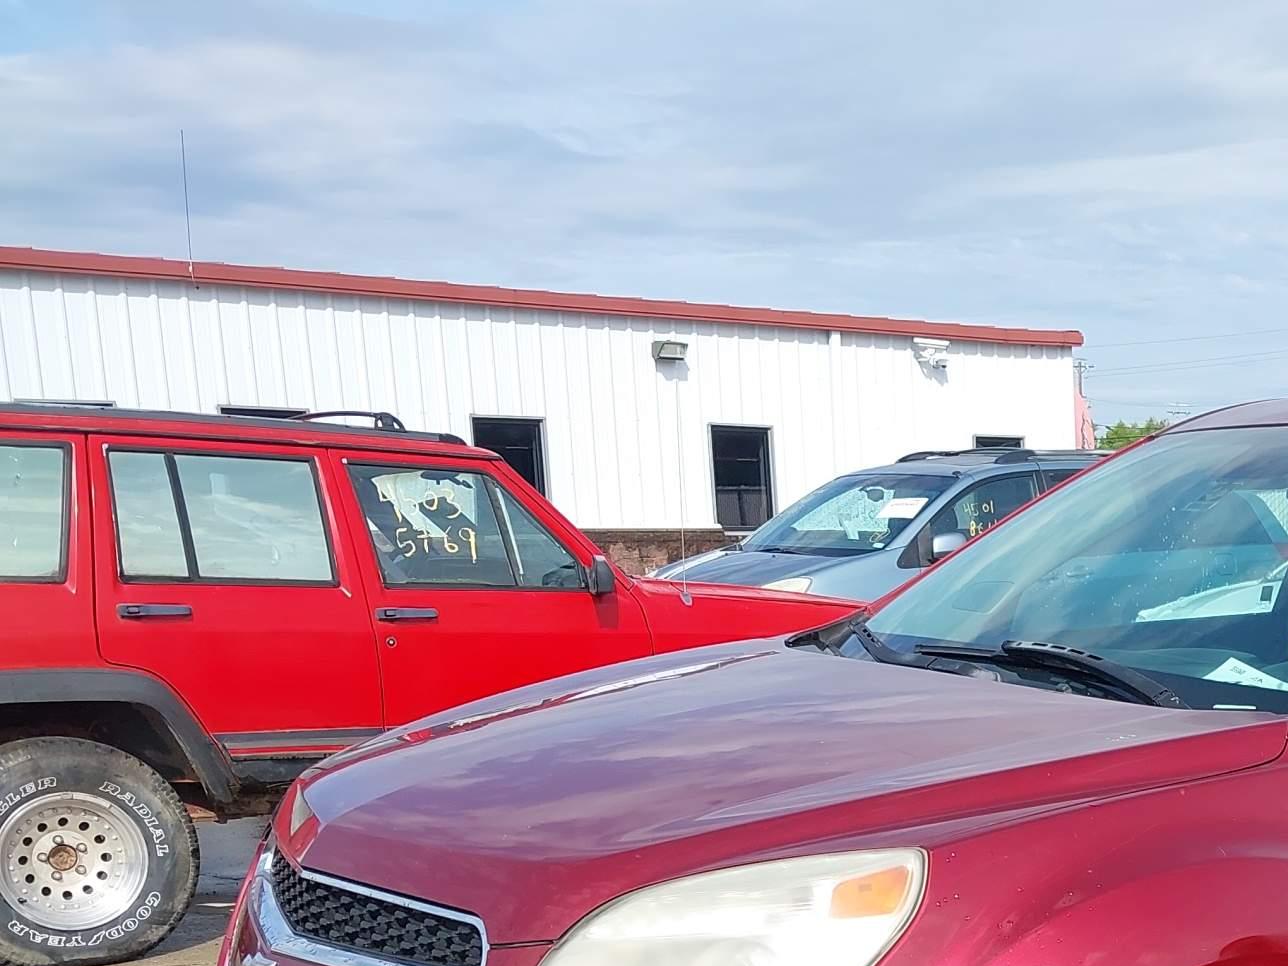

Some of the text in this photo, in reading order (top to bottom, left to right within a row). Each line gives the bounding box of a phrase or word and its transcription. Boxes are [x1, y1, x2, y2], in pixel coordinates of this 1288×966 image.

[380, 483, 461, 522] 4503
[396, 526, 477, 565] 5769
[99, 781, 169, 856] RADIAL
